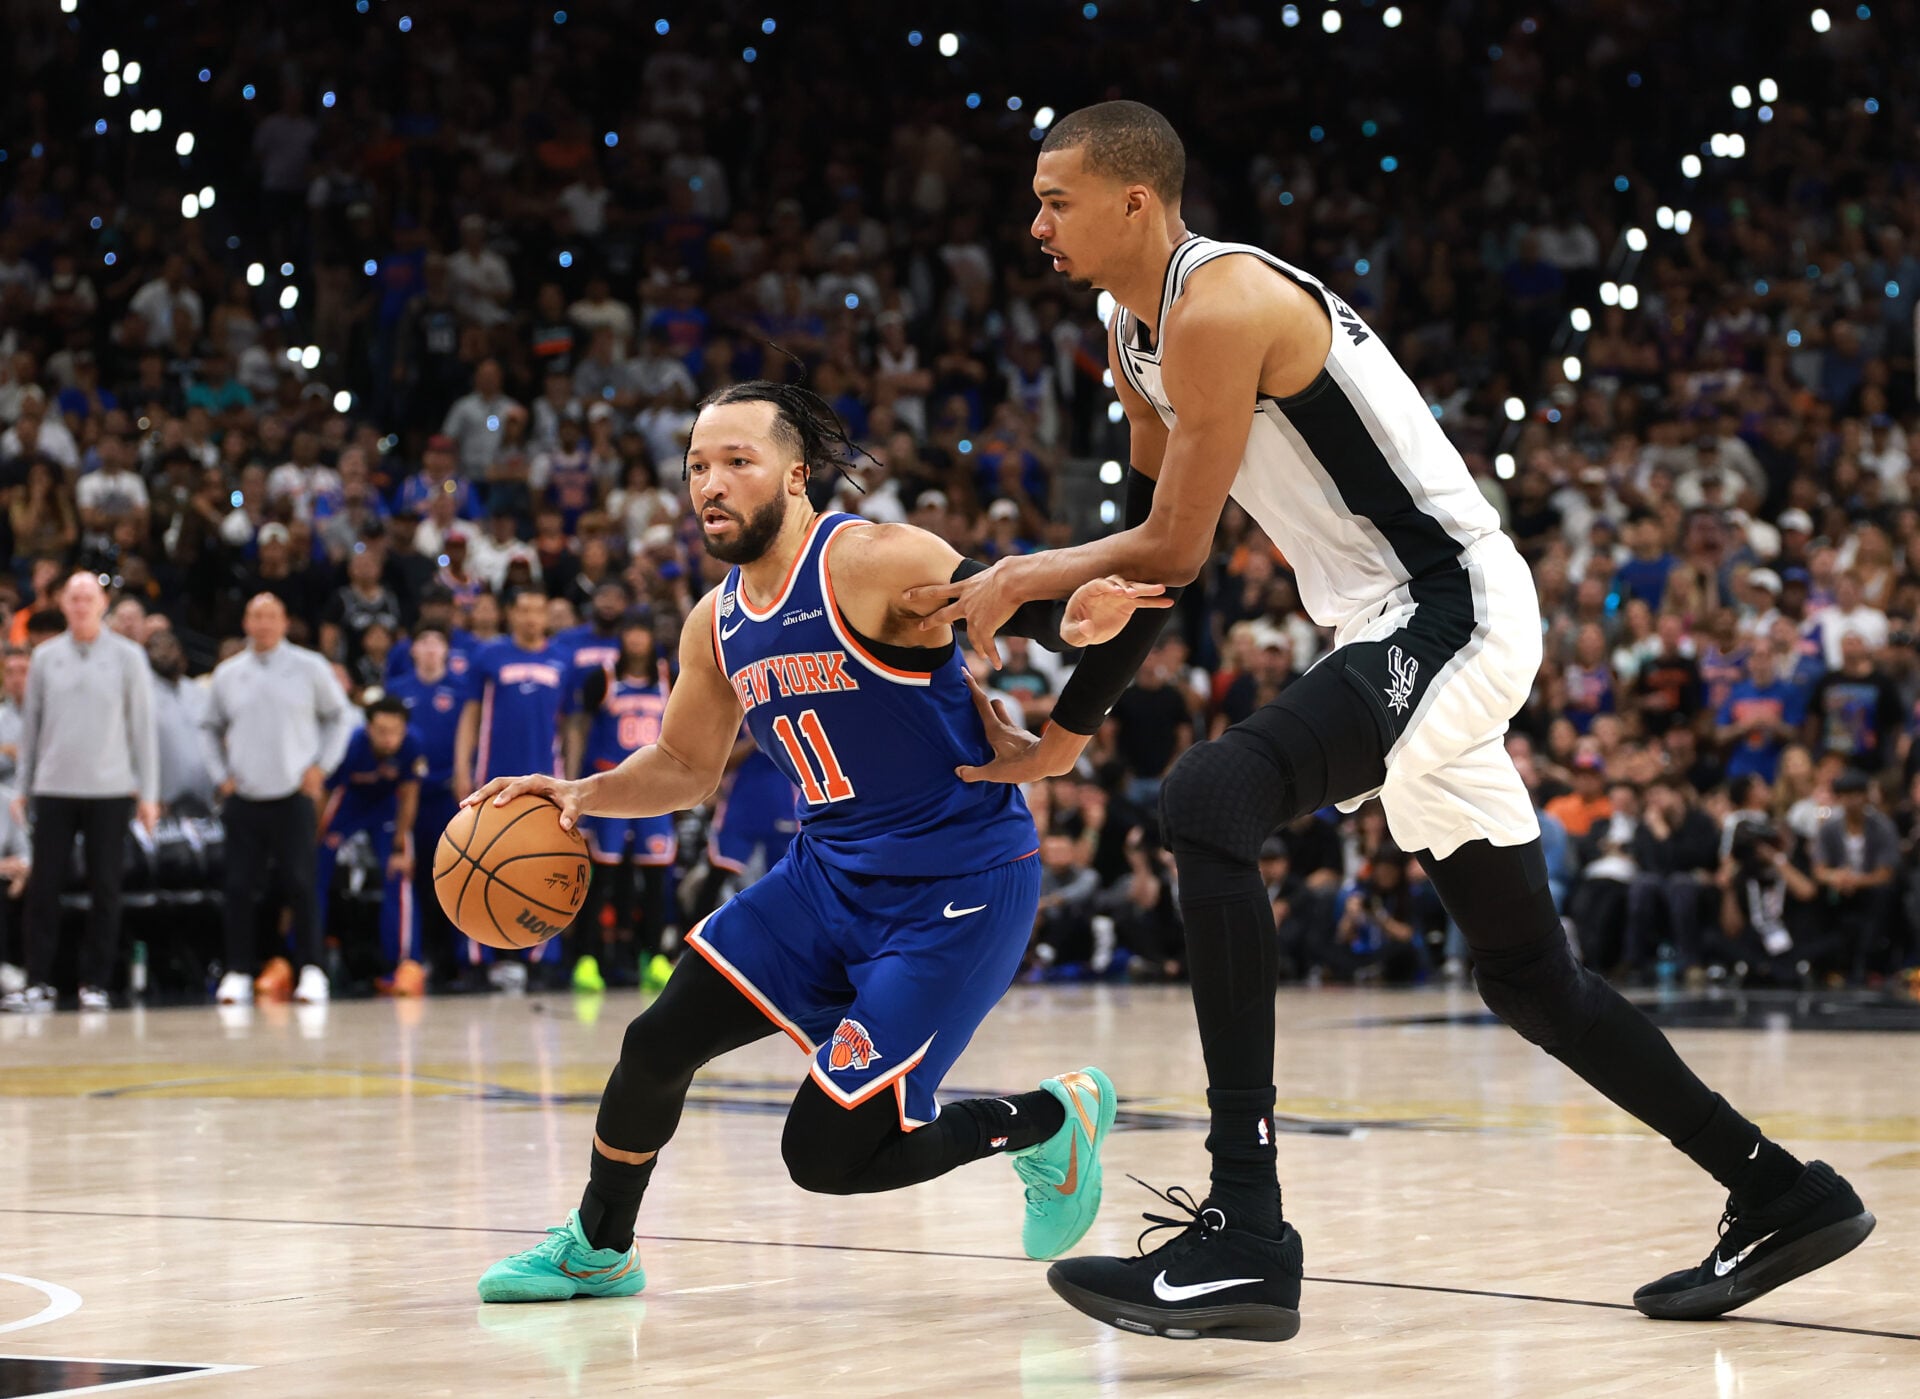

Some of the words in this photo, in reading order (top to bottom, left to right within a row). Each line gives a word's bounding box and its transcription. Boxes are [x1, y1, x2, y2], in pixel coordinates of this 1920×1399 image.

[1328, 293, 1370, 346] WE
[782, 614, 798, 627] abu
[798, 606, 824, 622] dhabi
[768, 651, 860, 697] YORK
[772, 708, 856, 806] 11
[836, 1021, 871, 1066] KNICKS
